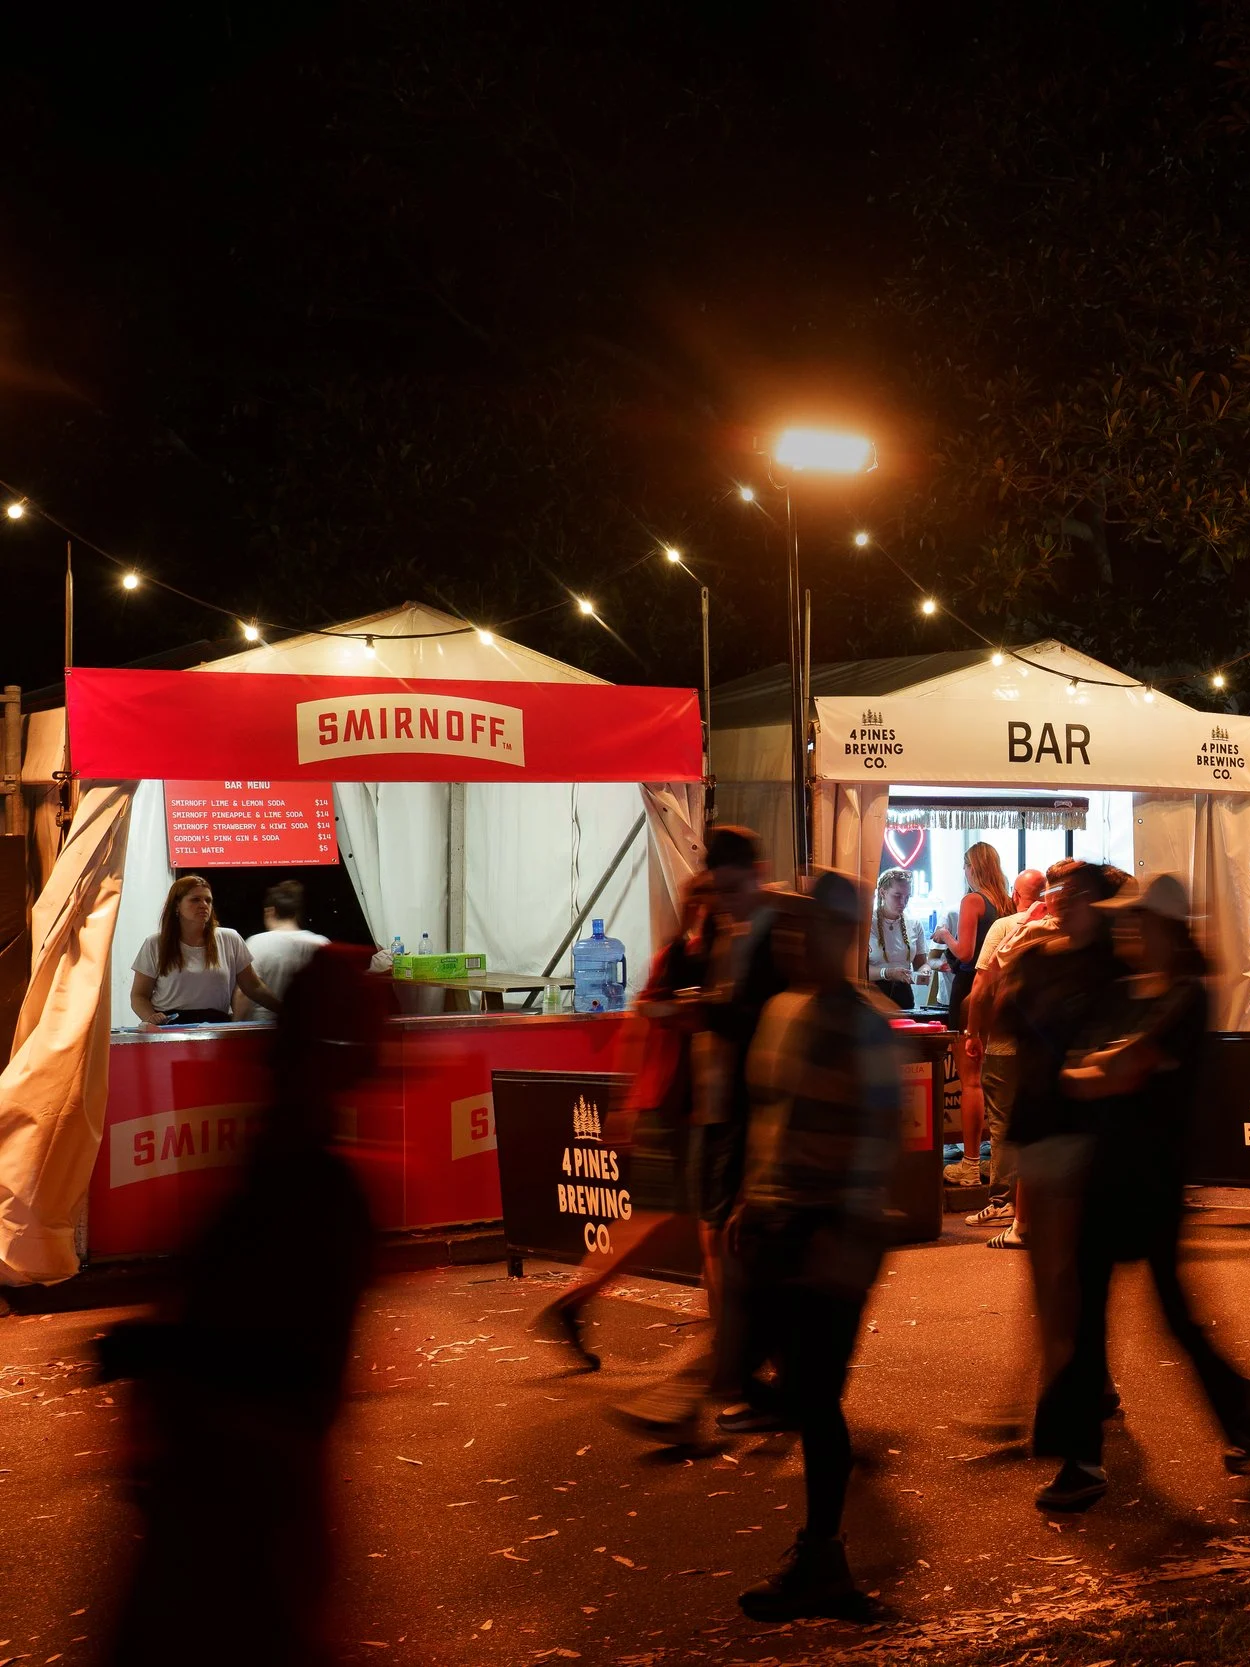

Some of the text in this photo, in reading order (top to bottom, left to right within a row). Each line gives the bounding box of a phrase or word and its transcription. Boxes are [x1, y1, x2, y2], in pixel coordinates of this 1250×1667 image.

[318, 707, 505, 747] SMIRNOFF
[849, 729, 896, 741] 4 PINES
[844, 743, 904, 756] BREWING
[1007, 721, 1091, 765] BAR
[1201, 743, 1240, 755] 4 PINES
[864, 756, 887, 769] CO.
[1196, 755, 1246, 768] BREWING
[1213, 769, 1232, 780] CO.
[225, 781, 270, 789] BAR MENU
[267, 799, 285, 807] SODA
[172, 811, 208, 819] SMIRNOFF
[562, 1147, 620, 1181] 4 PINES
[557, 1183, 632, 1221] BREWING
[584, 1222, 614, 1254] CO.
